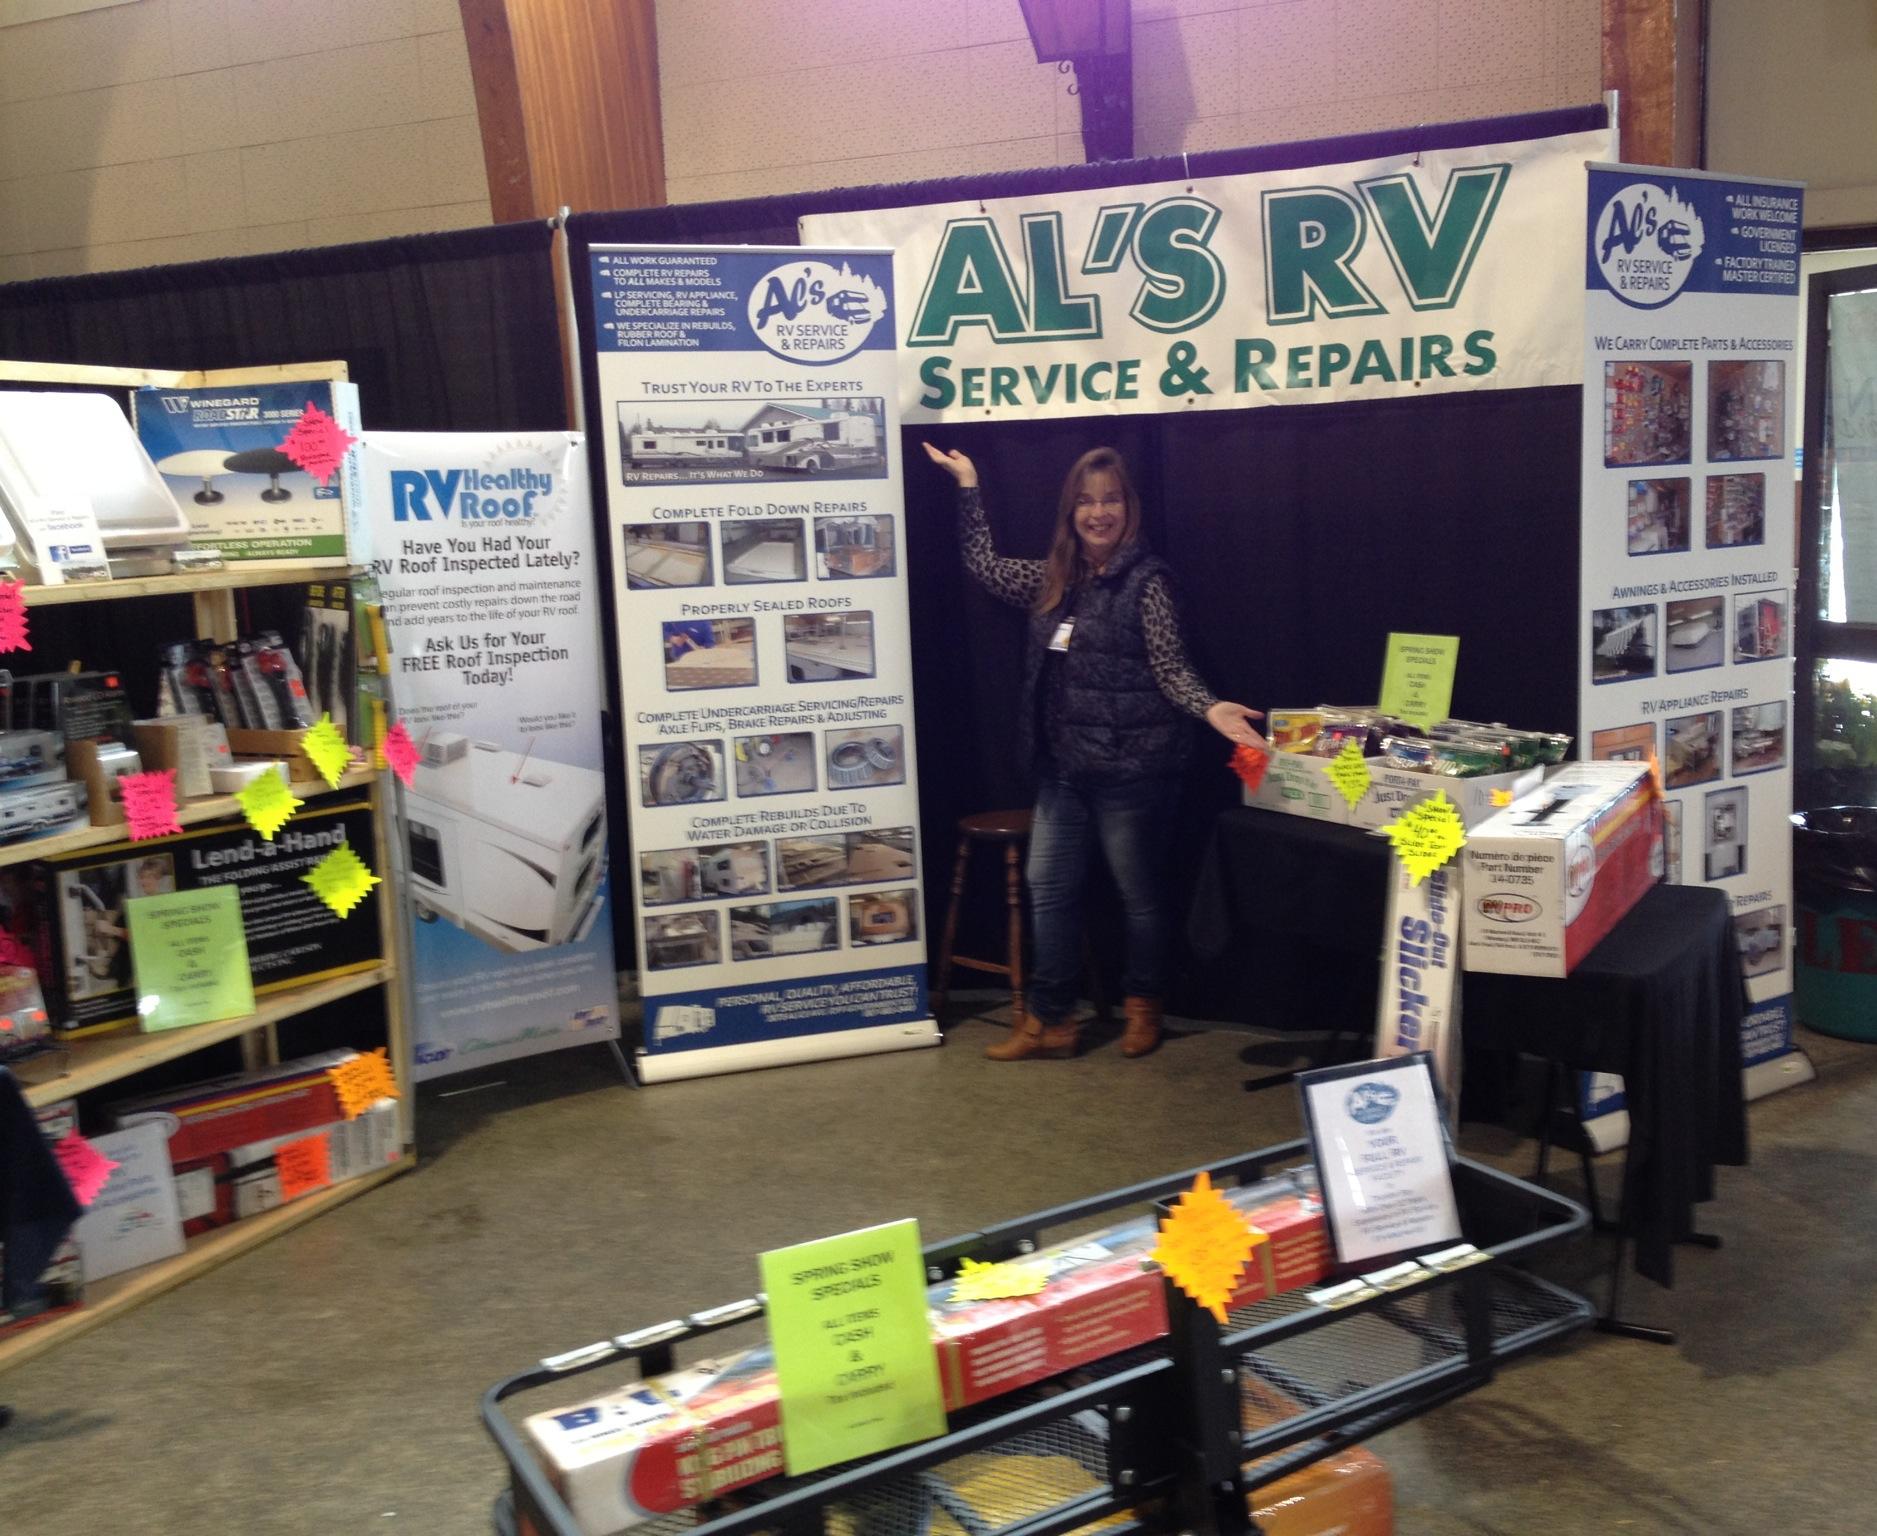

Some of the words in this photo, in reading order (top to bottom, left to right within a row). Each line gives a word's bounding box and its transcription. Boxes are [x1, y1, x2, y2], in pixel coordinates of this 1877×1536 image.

[1752, 196, 1798, 210] INSURANCE
[1602, 190, 1657, 264] Al's
[1740, 226, 1797, 240] GOVERNMENT
[906, 195, 1226, 348] AL'S
[1261, 163, 1511, 326] RV
[1760, 240, 1797, 254] LICENSED
[613, 256, 629, 265] ALL
[631, 256, 657, 265] WORK
[658, 257, 717, 265] GUARANTEED
[1617, 259, 1632, 272] RV
[1634, 259, 1673, 275] SERVICE
[1725, 256, 1762, 269] FACTORY
[613, 269, 660, 277] COMPLETE
[661, 269, 674, 277] RV
[675, 269, 710, 277] REPAIRS
[614, 277, 626, 286] TO
[628, 277, 645, 286] ALL
[646, 277, 676, 286] MAKES
[677, 277, 684, 286] &
[686, 278, 722, 286] MODELS
[1723, 270, 1759, 282] MASTER
[1620, 277, 1628, 289] &
[1630, 277, 1670, 291] REPAIRS
[615, 291, 625, 299] LP
[676, 292, 689, 300] RV
[615, 299, 661, 308] COMPLETE
[663, 299, 701, 308] BEARING
[702, 299, 709, 308] &
[757, 267, 826, 330] Al's
[616, 307, 689, 316] UNDERCARRIAGE
[690, 308, 726, 316] REPAIRS
[616, 322, 631, 330] WE
[633, 322, 679, 330] SPECIALIZE
[682, 322, 691, 330] IN
[617, 330, 652, 338] RUBBER
[653, 330, 678, 338] ROOF
[679, 330, 686, 338] &
[777, 324, 795, 336] RV
[796, 324, 848, 336] SERVICE
[618, 338, 644, 346] FILON
[645, 338, 699, 347] LAMINATION
[781, 338, 790, 350] &
[794, 338, 845, 350] REPAIRS
[1595, 336, 1613, 350] WE
[1615, 336, 1648, 350] CARRY
[1649, 336, 1699, 350] COMPLETE
[1701, 337, 1728, 350] PARTS
[1730, 338, 1737, 350] &
[1740, 337, 1793, 351] ACCESSORIES
[920, 357, 1141, 410] SERVICE
[1159, 340, 1211, 398] &
[1234, 330, 1496, 393] REPAIRS
[641, 381, 688, 394] TRUST
[689, 381, 728, 394] YOUR
[732, 380, 753, 393] RV
[754, 380, 773, 393] TO
[775, 380, 802, 392] THE
[806, 380, 863, 392] EXPERTS
[190, 397, 259, 408] WINEGARD
[463, 468, 552, 496] Healthy
[626, 472, 641, 481] RV
[707, 470, 734, 479] WHAT
[735, 470, 749, 479] WE
[750, 469, 764, 478] DO
[390, 469, 464, 521] RV
[460, 491, 538, 519] Roof
[653, 507, 724, 520] COMPLETE
[729, 505, 763, 517] FOLD
[767, 503, 810, 516] DOWN
[814, 501, 867, 513] REPAIRS
[251, 538, 313, 549] OPERATION
[403, 539, 441, 555] Have
[446, 538, 476, 554] You
[483, 537, 512, 552] Had
[516, 536, 551, 551] Your
[372, 559, 392, 575] RV
[400, 556, 437, 573] Roof
[442, 553, 520, 575] Inspected
[527, 551, 581, 570] Lately?
[418, 584, 439, 597] roof
[442, 583, 496, 599] inspection
[497, 581, 516, 593] and
[519, 580, 582, 592] maintenance
[1612, 584, 1659, 599] AWNINGS
[1661, 582, 1667, 594] &
[1669, 576, 1729, 593] ACCESSORIES
[1731, 571, 1778, 586] INSTALLED
[400, 600, 440, 616] prevent
[442, 597, 473, 613] costly
[475, 597, 509, 611] repairs
[510, 593, 539, 605] down
[540, 591, 558, 603] the
[559, 590, 581, 601] road
[682, 602, 750, 616] PROPERLY
[753, 600, 805, 613] SEALED
[808, 597, 852, 609] ROOFS
[404, 614, 425, 626] add
[427, 612, 454, 627] years
[456, 612, 467, 622] to
[469, 610, 487, 621] the
[489, 608, 504, 619] life
[506, 607, 516, 619] of
[518, 608, 541, 621] your
[543, 606, 556, 616] RV
[426, 637, 454, 653] Ask
[460, 635, 479, 650] Us
[484, 633, 506, 648] for
[510, 631, 546, 647] Your
[402, 656, 441, 673] FREE
[446, 653, 483, 669] Roof
[487, 647, 569, 666] Inspection
[462, 667, 514, 687] Today!
[1642, 700, 1658, 715] RV
[1659, 694, 1710, 713] APPLIANCE
[1711, 688, 1749, 703] REPAIRS
[637, 710, 700, 724] COMPLETE
[701, 701, 797, 720] UNDERCARRIAGE
[658, 722, 689, 736] AXLE
[728, 717, 768, 731] BRAKE
[769, 714, 815, 727] REPAIRS
[817, 713, 826, 724] &
[827, 709, 887, 723] ADJUSTING
[692, 812, 756, 828] COMPLETE
[760, 806, 820, 822] REBUILDS
[822, 804, 847, 818] DUE
[849, 803, 867, 815] TO
[687, 828, 732, 842] WATER
[733, 822, 788, 838] DAMAGE
[790, 820, 807, 833] OR
[809, 815, 872, 831] COLLISION
[191, 822, 347, 870] Lend-a-Hand
[1481, 862, 1503, 873] Part
[1504, 864, 1545, 874] Number
[1396, 914, 1432, 1050] Slicker
